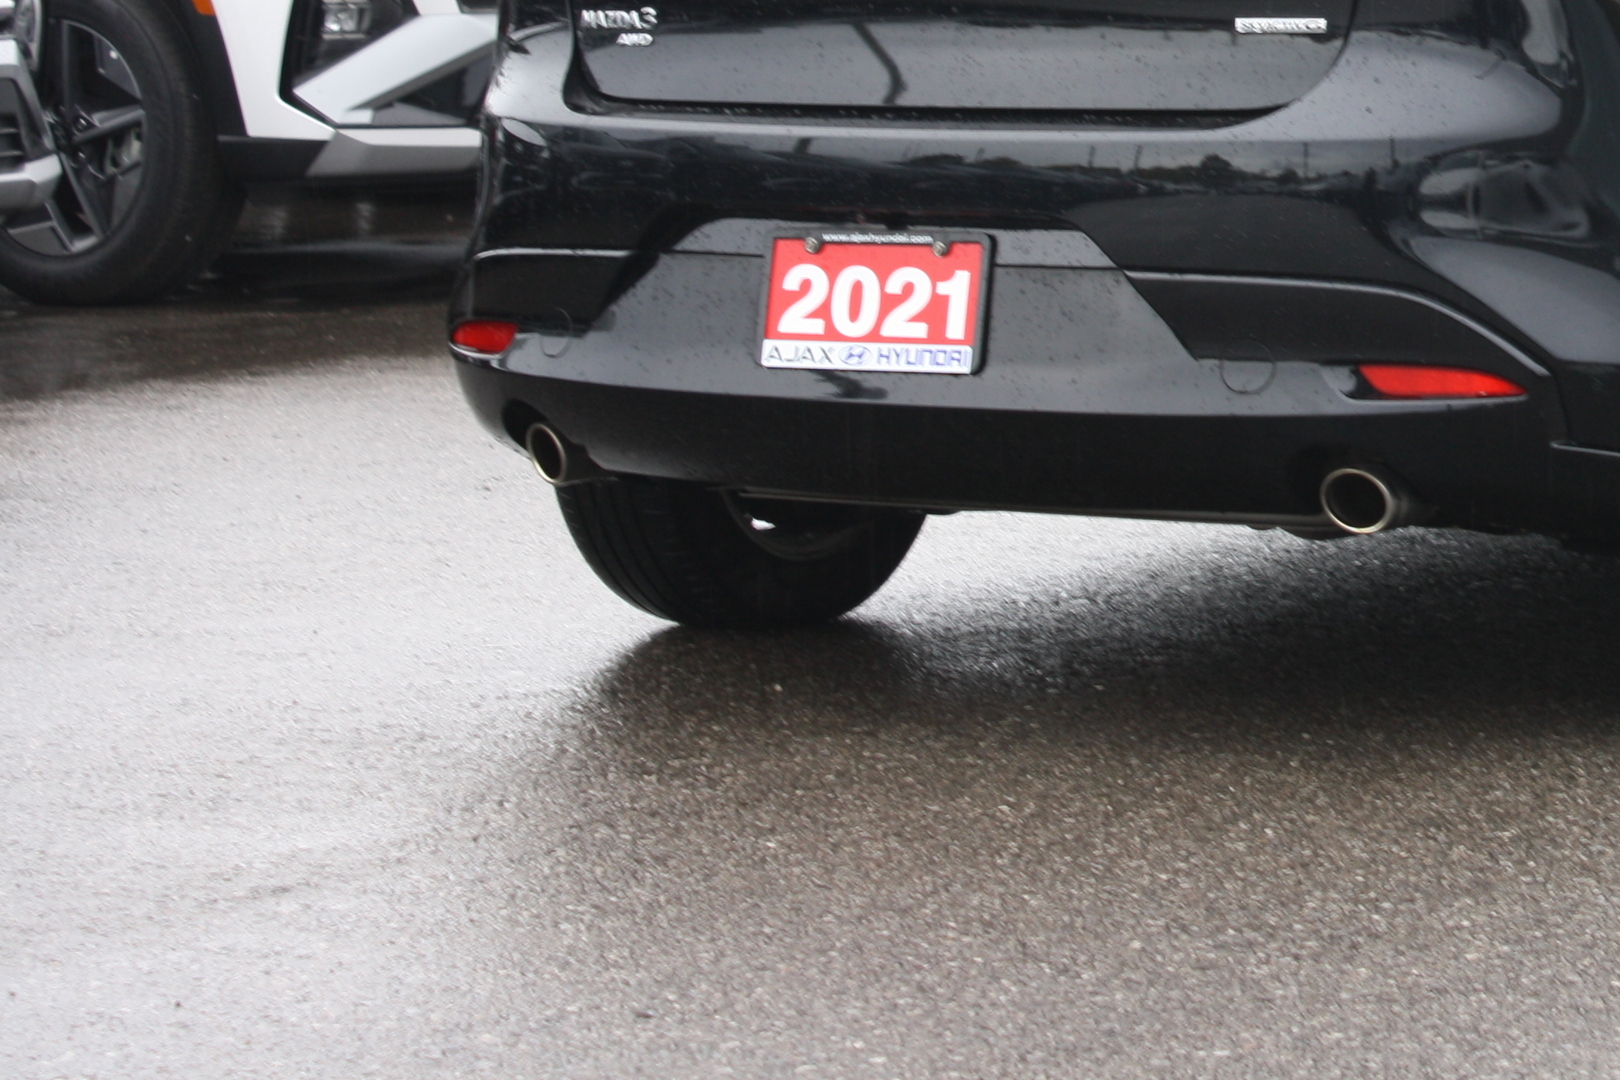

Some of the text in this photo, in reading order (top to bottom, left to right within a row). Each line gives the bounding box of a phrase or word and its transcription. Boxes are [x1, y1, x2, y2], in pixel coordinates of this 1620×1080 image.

[777, 263, 971, 340] 2021
[763, 345, 971, 368] AJAX HYUNDAI
